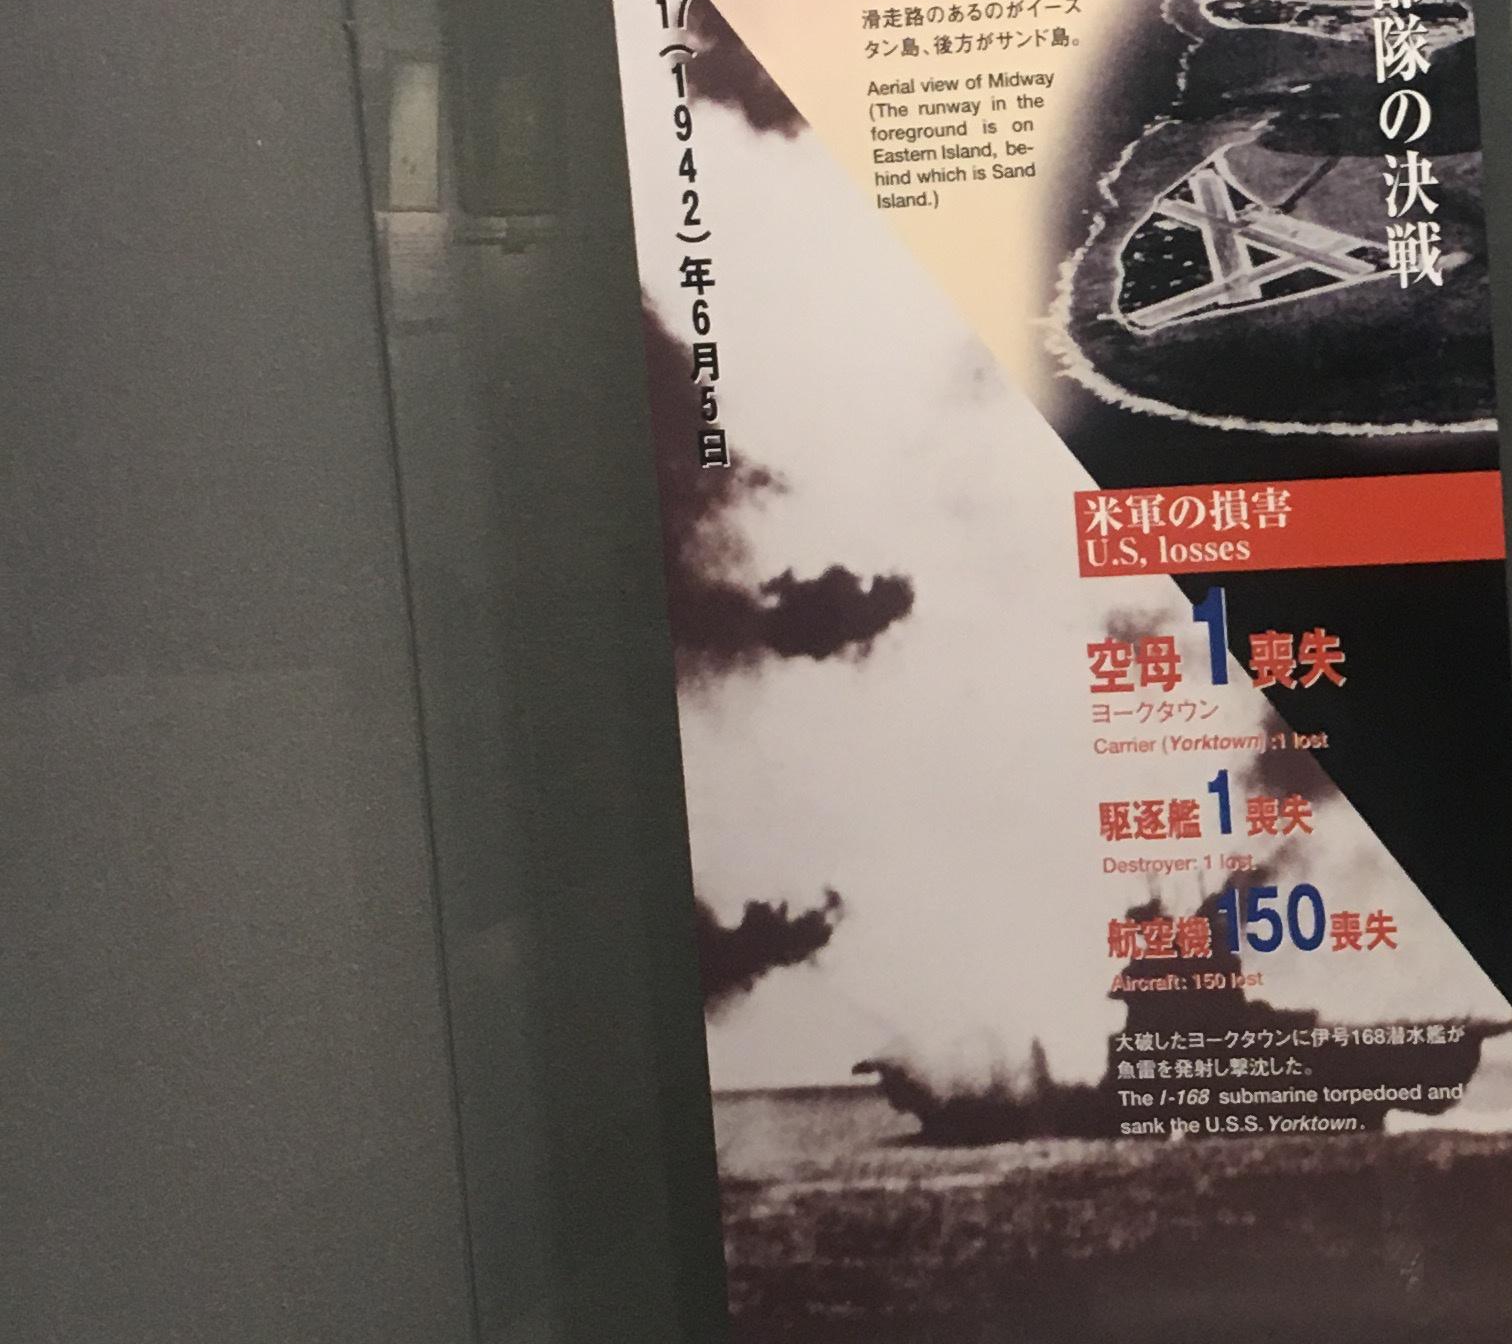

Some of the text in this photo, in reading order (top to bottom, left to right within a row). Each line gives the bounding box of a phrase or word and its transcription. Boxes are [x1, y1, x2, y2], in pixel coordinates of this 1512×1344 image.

[864, 26, 1081, 59] タン島、後方がサンド島。
[867, 71, 1055, 96] Aerial view of Midway
[868, 94, 1046, 122] (The runway in the
[870, 118, 1034, 143] foreground is on
[873, 140, 1035, 164] Eastern Island, be-
[875, 162, 1036, 187] hind which is Sand
[876, 189, 940, 209] Island.)
[1084, 487, 1293, 536] 米軍の損害
[1159, 535, 1251, 563] losses
[1086, 586, 1348, 693] 空母1喪失
[1091, 700, 1219, 724] ヨークタウン
[1093, 737, 1156, 756] Carrier
[1162, 731, 1267, 755] (Yorktown)
[1293, 730, 1330, 751] lost
[1099, 769, 1313, 841] 駆逐艦1喪失
[1103, 857, 1198, 875] Destroyer:
[1203, 855, 1212, 870] 1
[1107, 883, 1399, 960] 航空機150喪失
[1111, 971, 1264, 992] Aircraft: 150 lost
[1115, 1025, 1467, 1052] 大破したヨークタウンに伊号168潜水艦が
[1117, 1058, 1314, 1080] 魚雷を発射し撃沈した。
[1118, 1088, 1154, 1106] The
[1218, 1086, 1319, 1105] submarine
[1323, 1084, 1423, 1107] torpedoed
[1427, 1083, 1464, 1101] and
[1120, 1113, 1366, 1135] sank the U.S.S. Yorktown.
